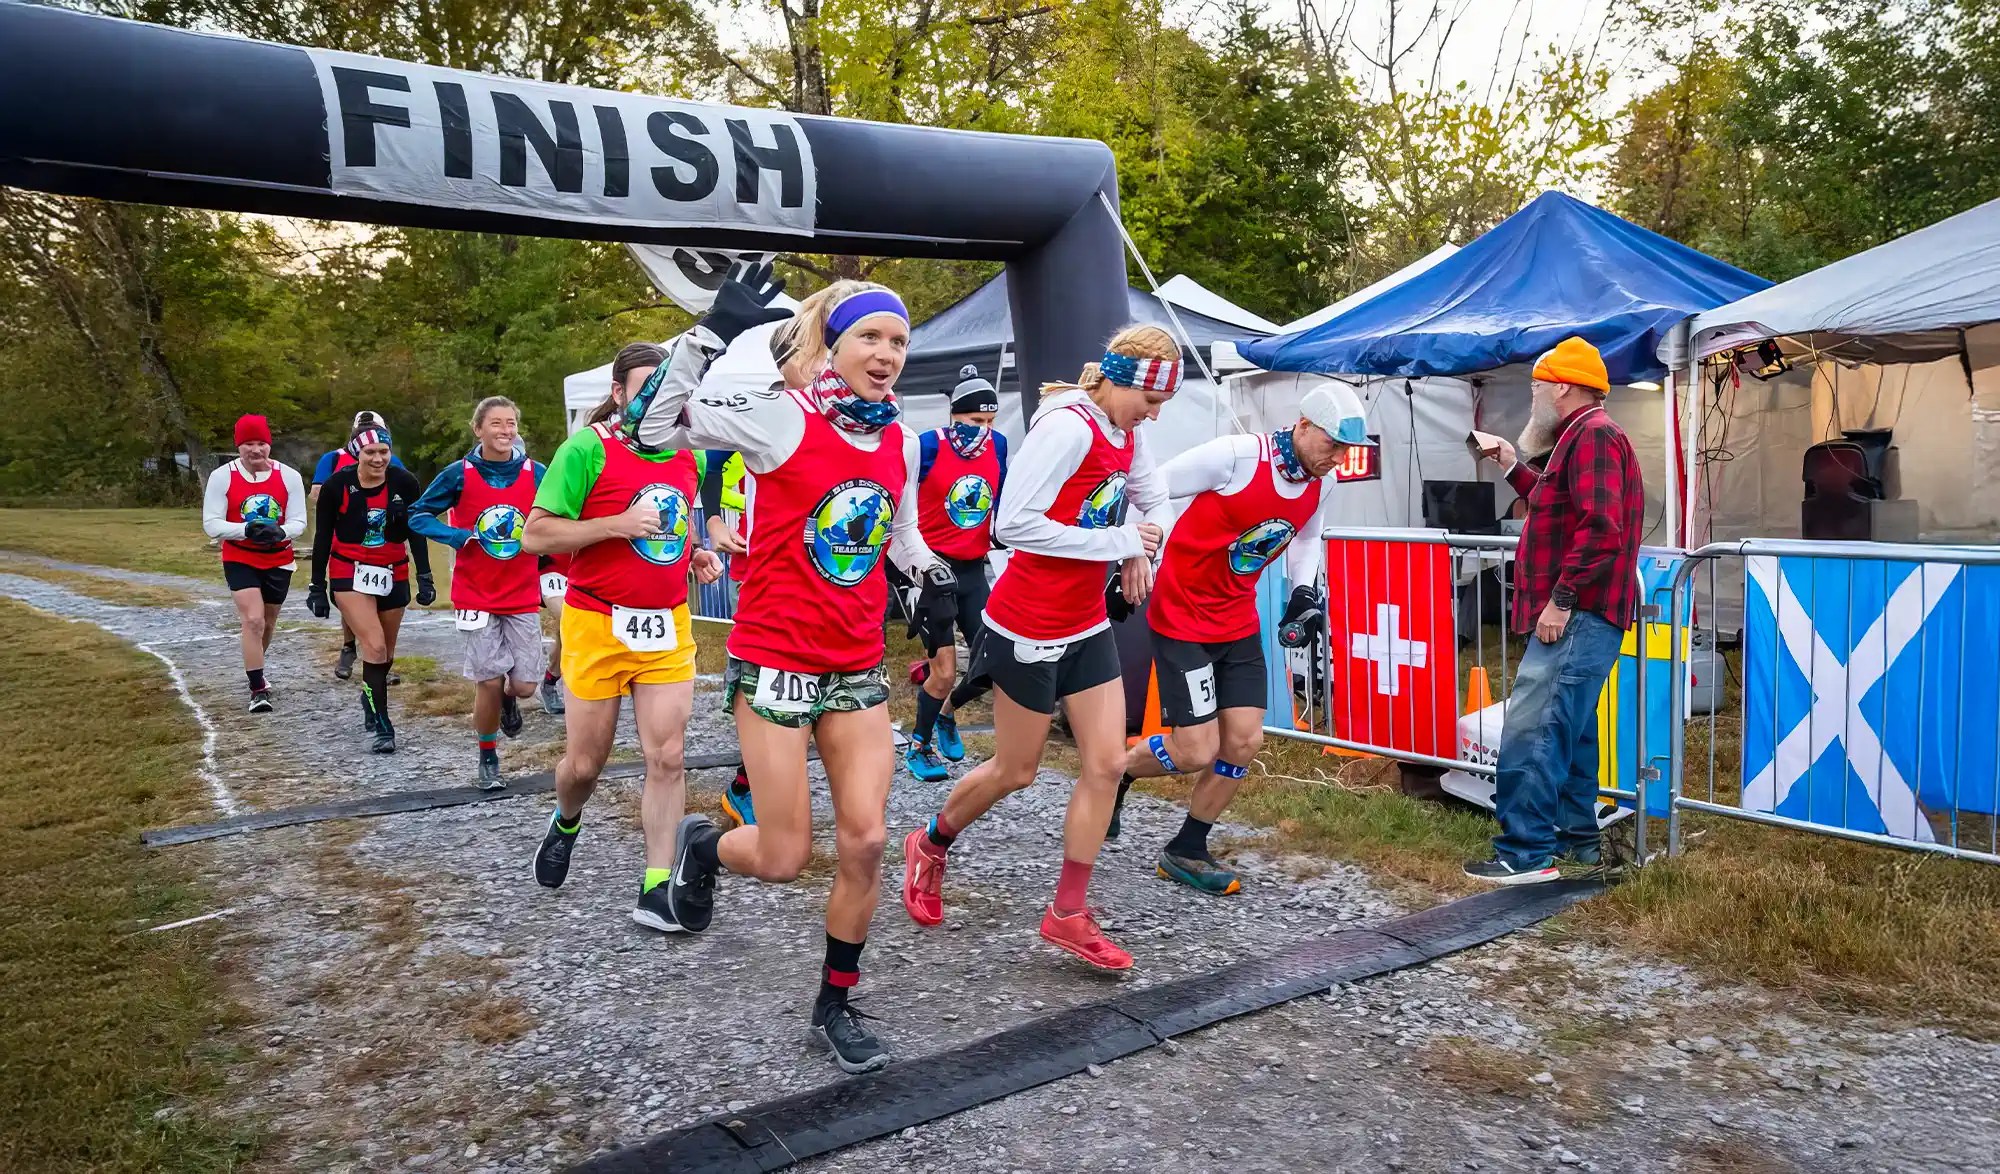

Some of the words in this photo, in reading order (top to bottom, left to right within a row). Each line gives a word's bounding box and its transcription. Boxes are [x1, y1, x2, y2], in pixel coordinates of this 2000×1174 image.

[331, 66, 804, 208] FINISH
[362, 572, 387, 589] 444
[548, 578, 568, 591] 41
[626, 615, 666, 639] 443
[770, 671, 820, 703] 409
